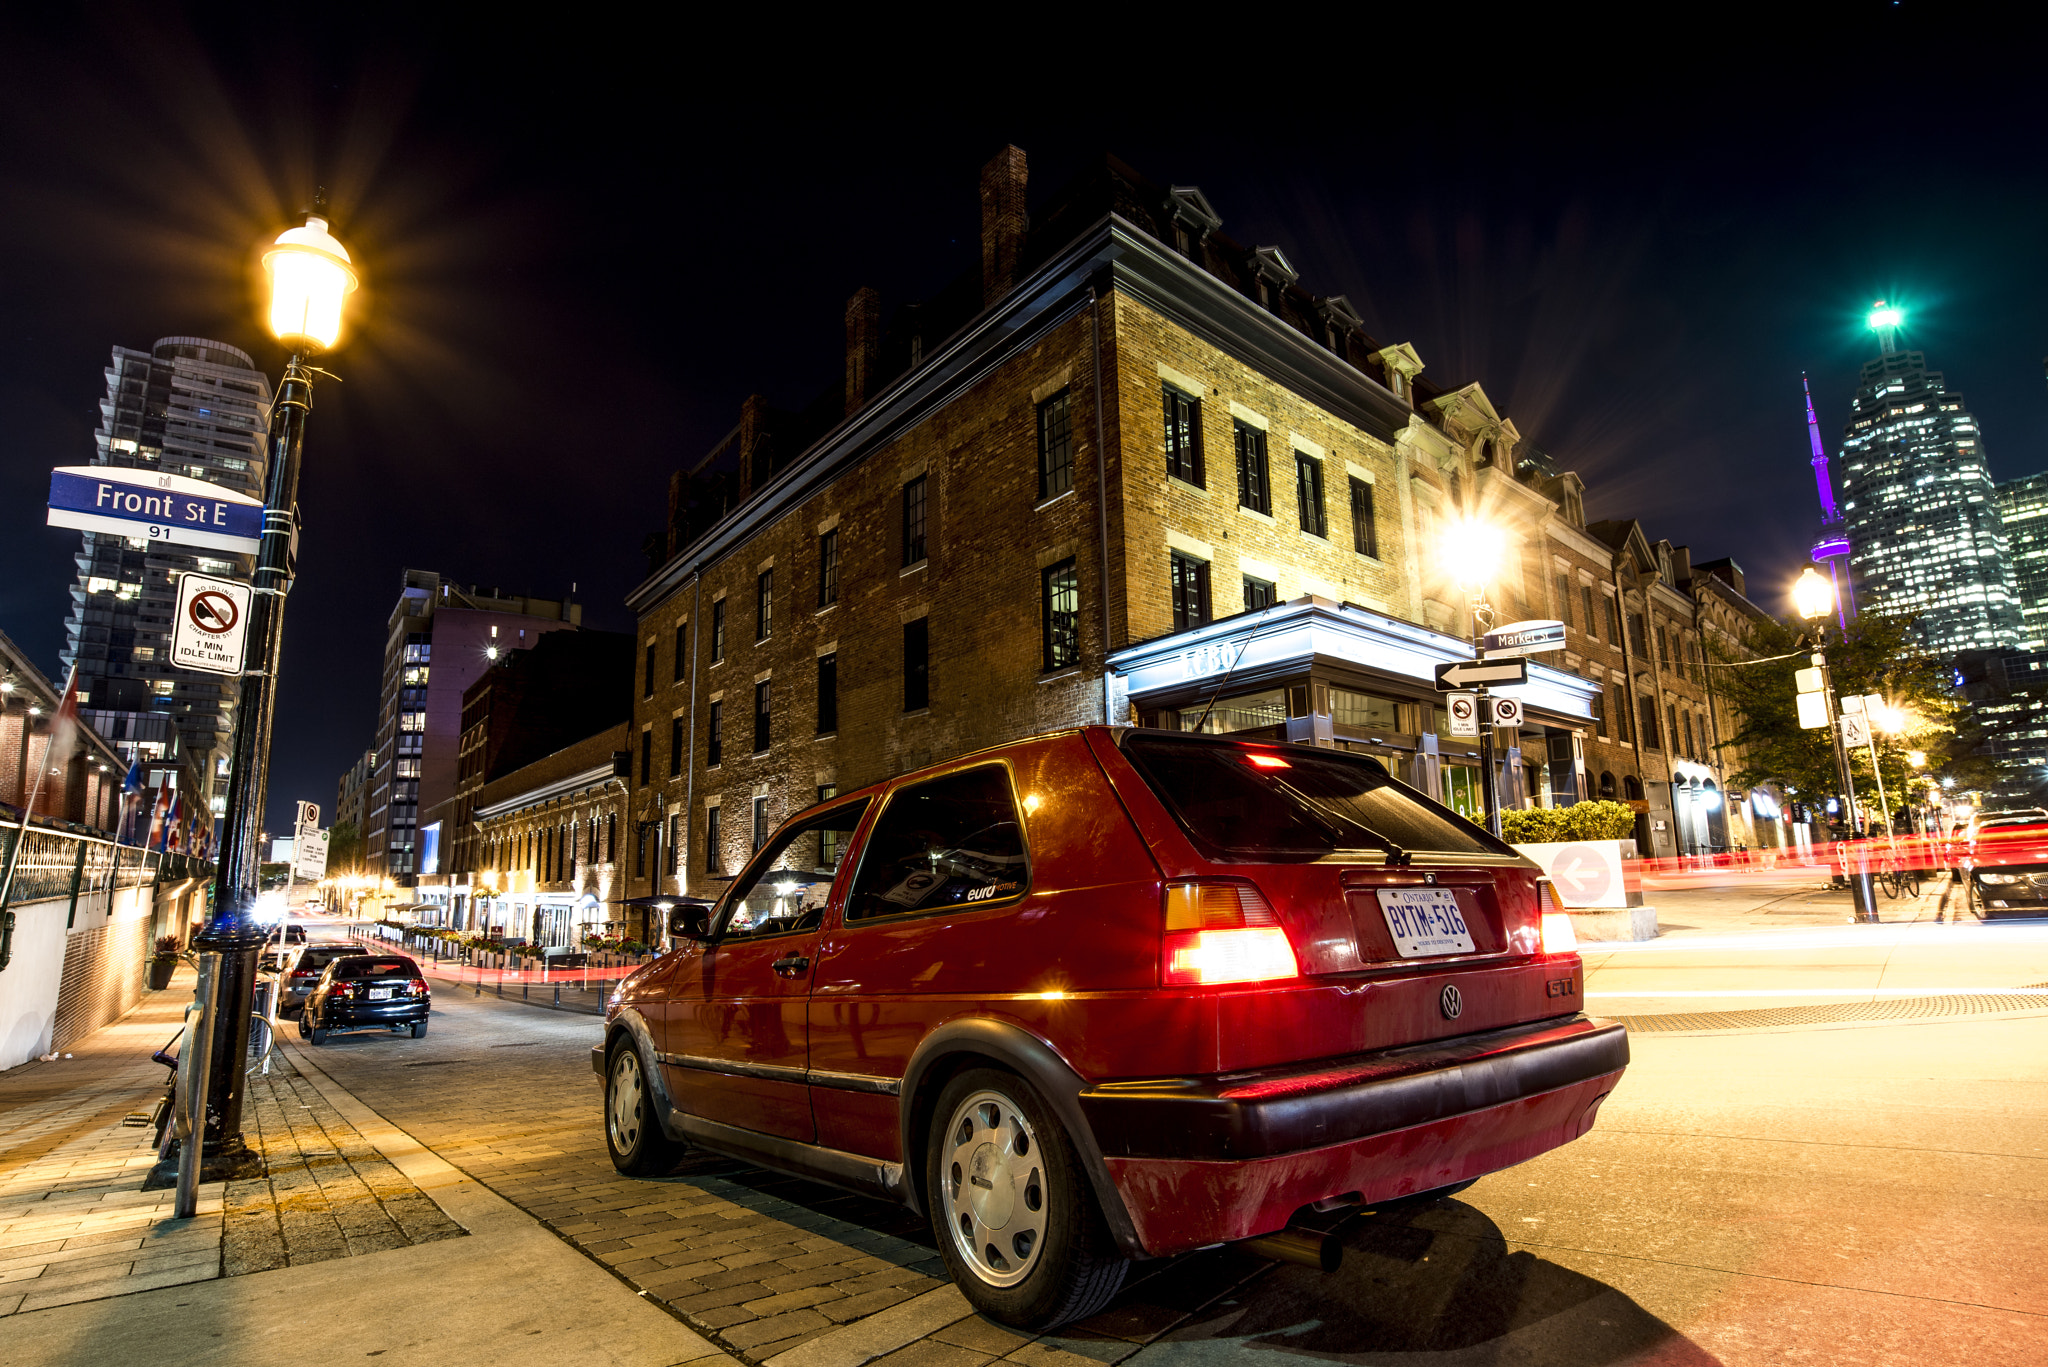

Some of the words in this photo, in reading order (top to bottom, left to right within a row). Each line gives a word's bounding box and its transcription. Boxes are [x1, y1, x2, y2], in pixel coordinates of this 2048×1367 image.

[96, 483, 173, 518] Front
[185, 502, 207, 523] St
[213, 502, 228, 526] E
[149, 525, 171, 540] 91
[194, 585, 207, 593] NO
[208, 585, 235, 599] IDLING
[188, 623, 221, 640] CHAPTER
[1498, 632, 1535, 647] Market
[1540, 632, 1549, 641] St
[195, 640, 201, 648] 1
[204, 641, 223, 652] MIN
[180, 647, 205, 659] IDLE
[208, 651, 235, 663] LIMIT
[1181, 642, 1236, 680] LCBO
[967, 884, 996, 901] euro
[1402, 892, 1434, 904] ONTARIO
[1387, 904, 1434, 938] BYTM
[1431, 904, 1466, 935] 516
[1547, 977, 1575, 998] GTI
